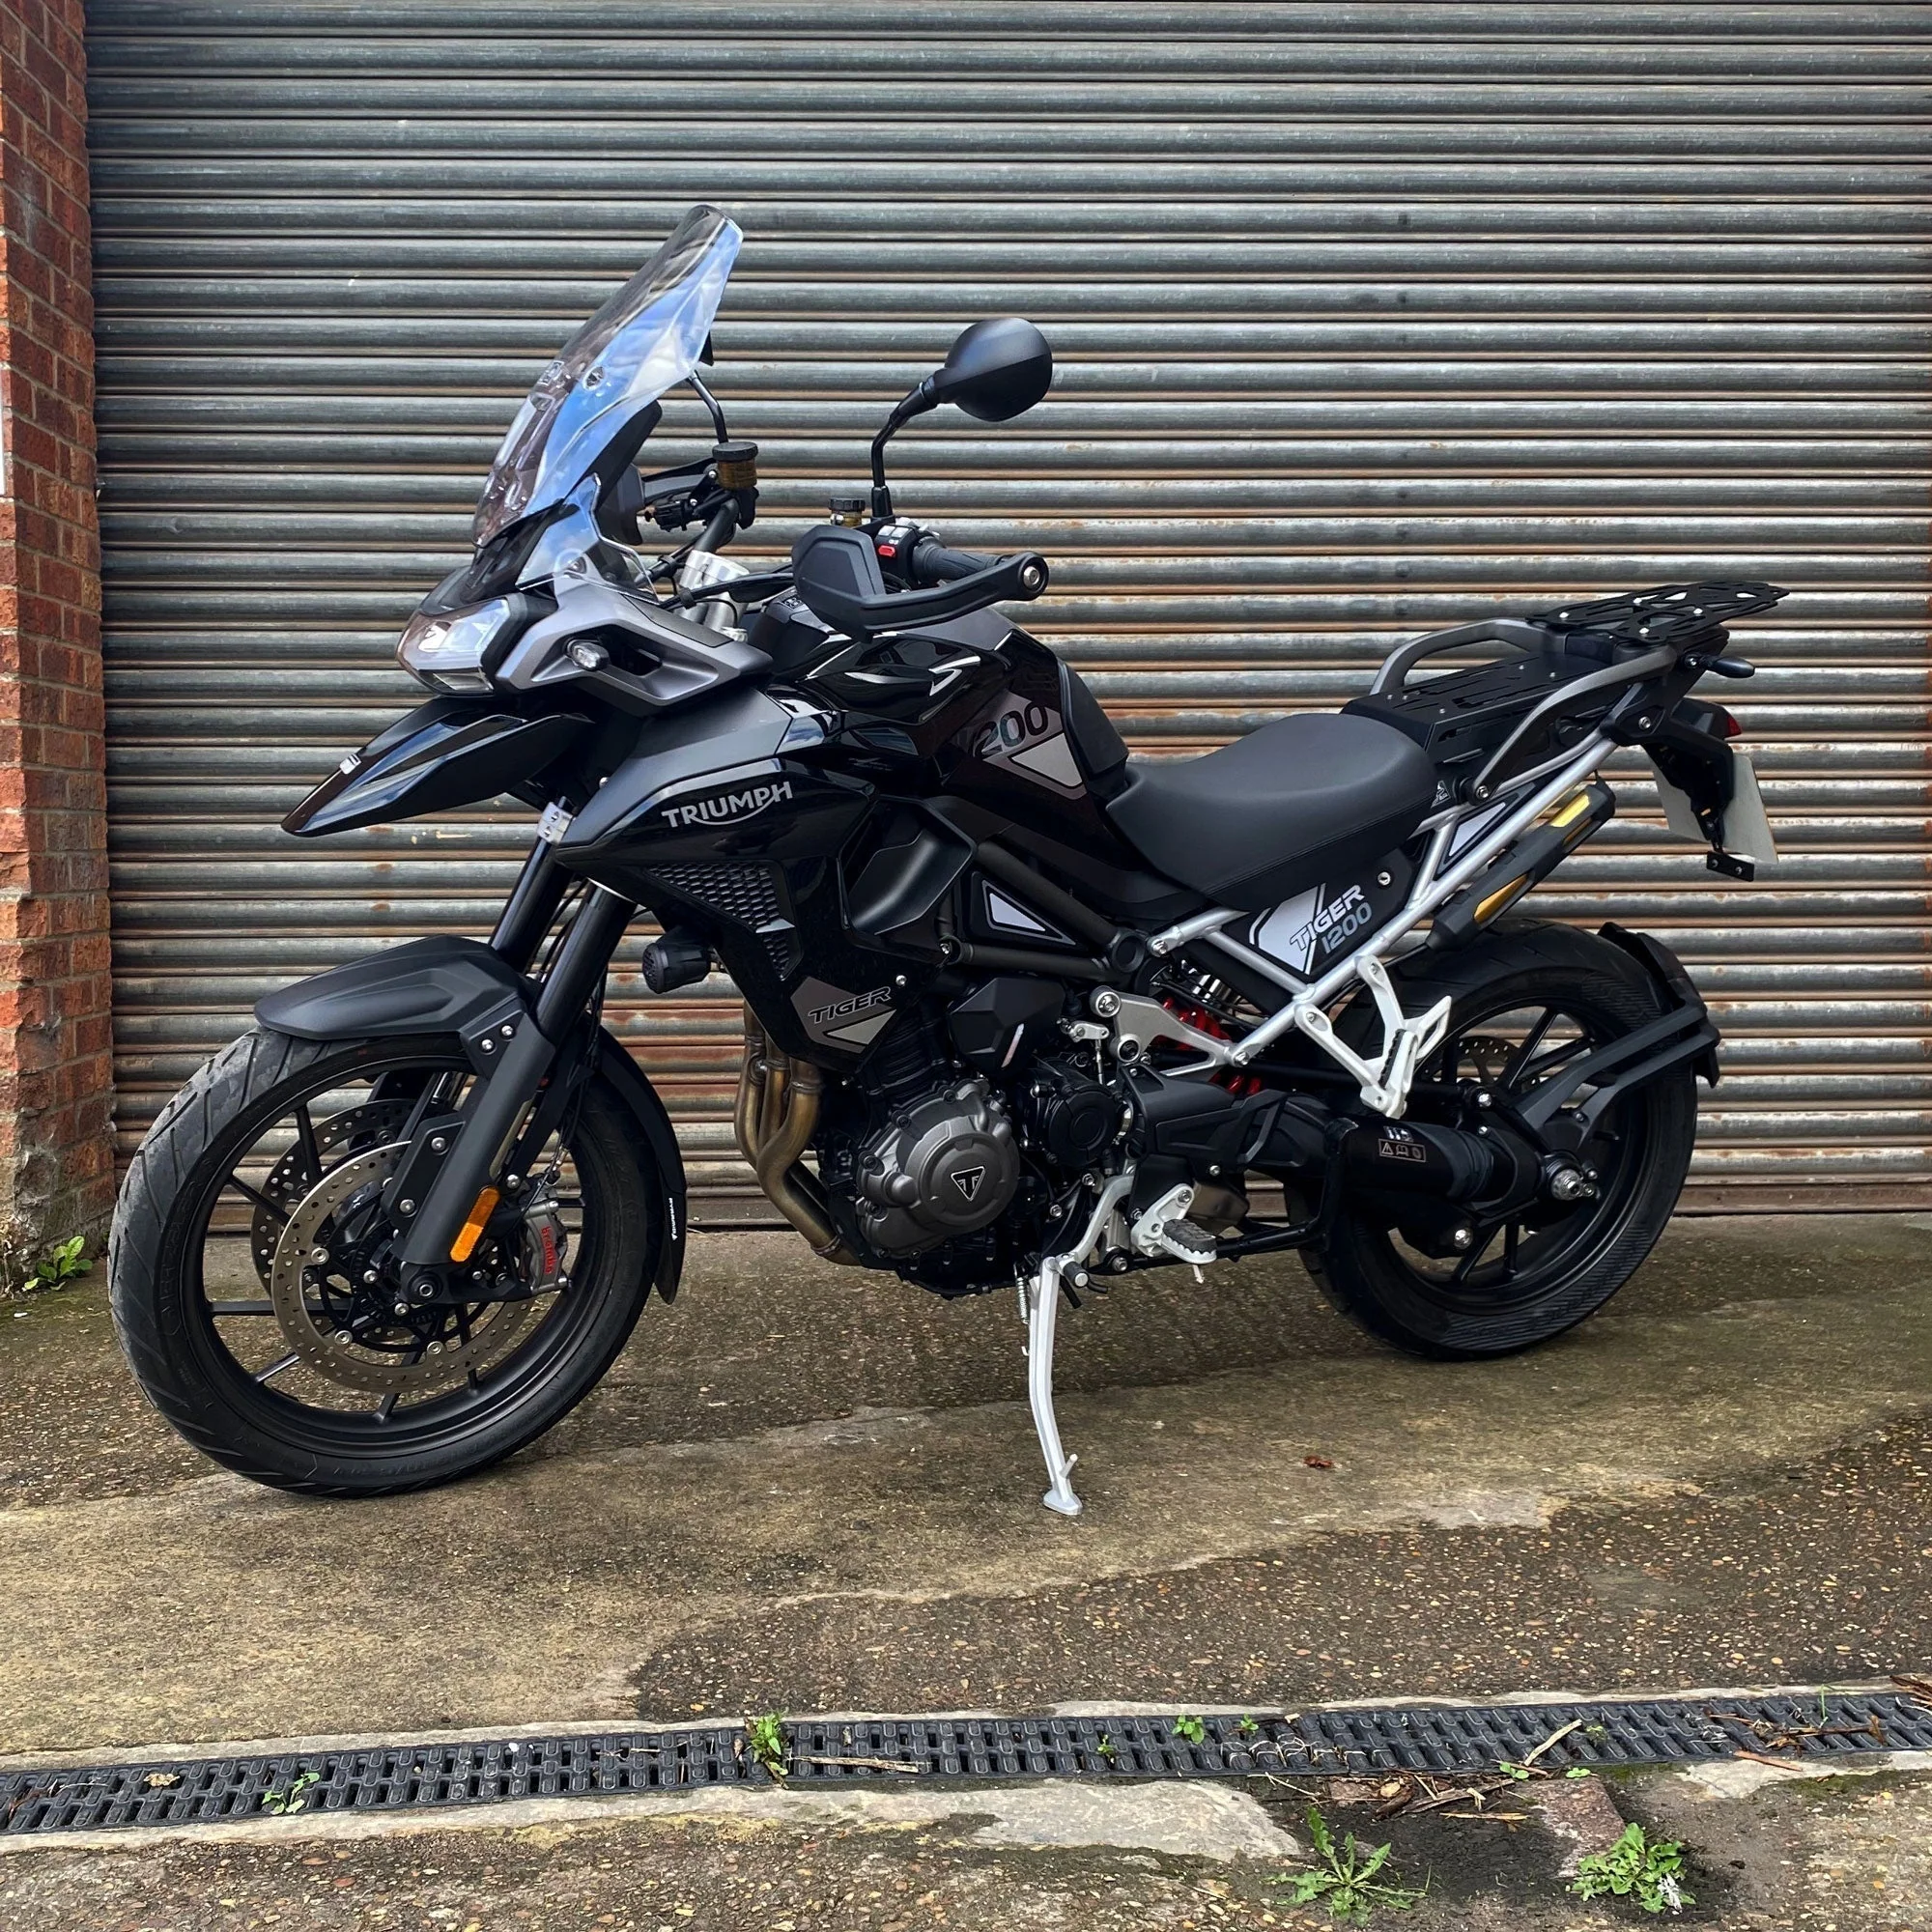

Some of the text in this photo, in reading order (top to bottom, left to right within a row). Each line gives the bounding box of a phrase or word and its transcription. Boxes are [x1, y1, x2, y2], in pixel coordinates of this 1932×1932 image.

[661, 781, 793, 828] TRIUMPH
[1290, 884, 1365, 951] TIGER
[1321, 901, 1373, 953] 1200
[808, 986, 892, 1024] TIGER
[541, 1226, 557, 1274] brembo
